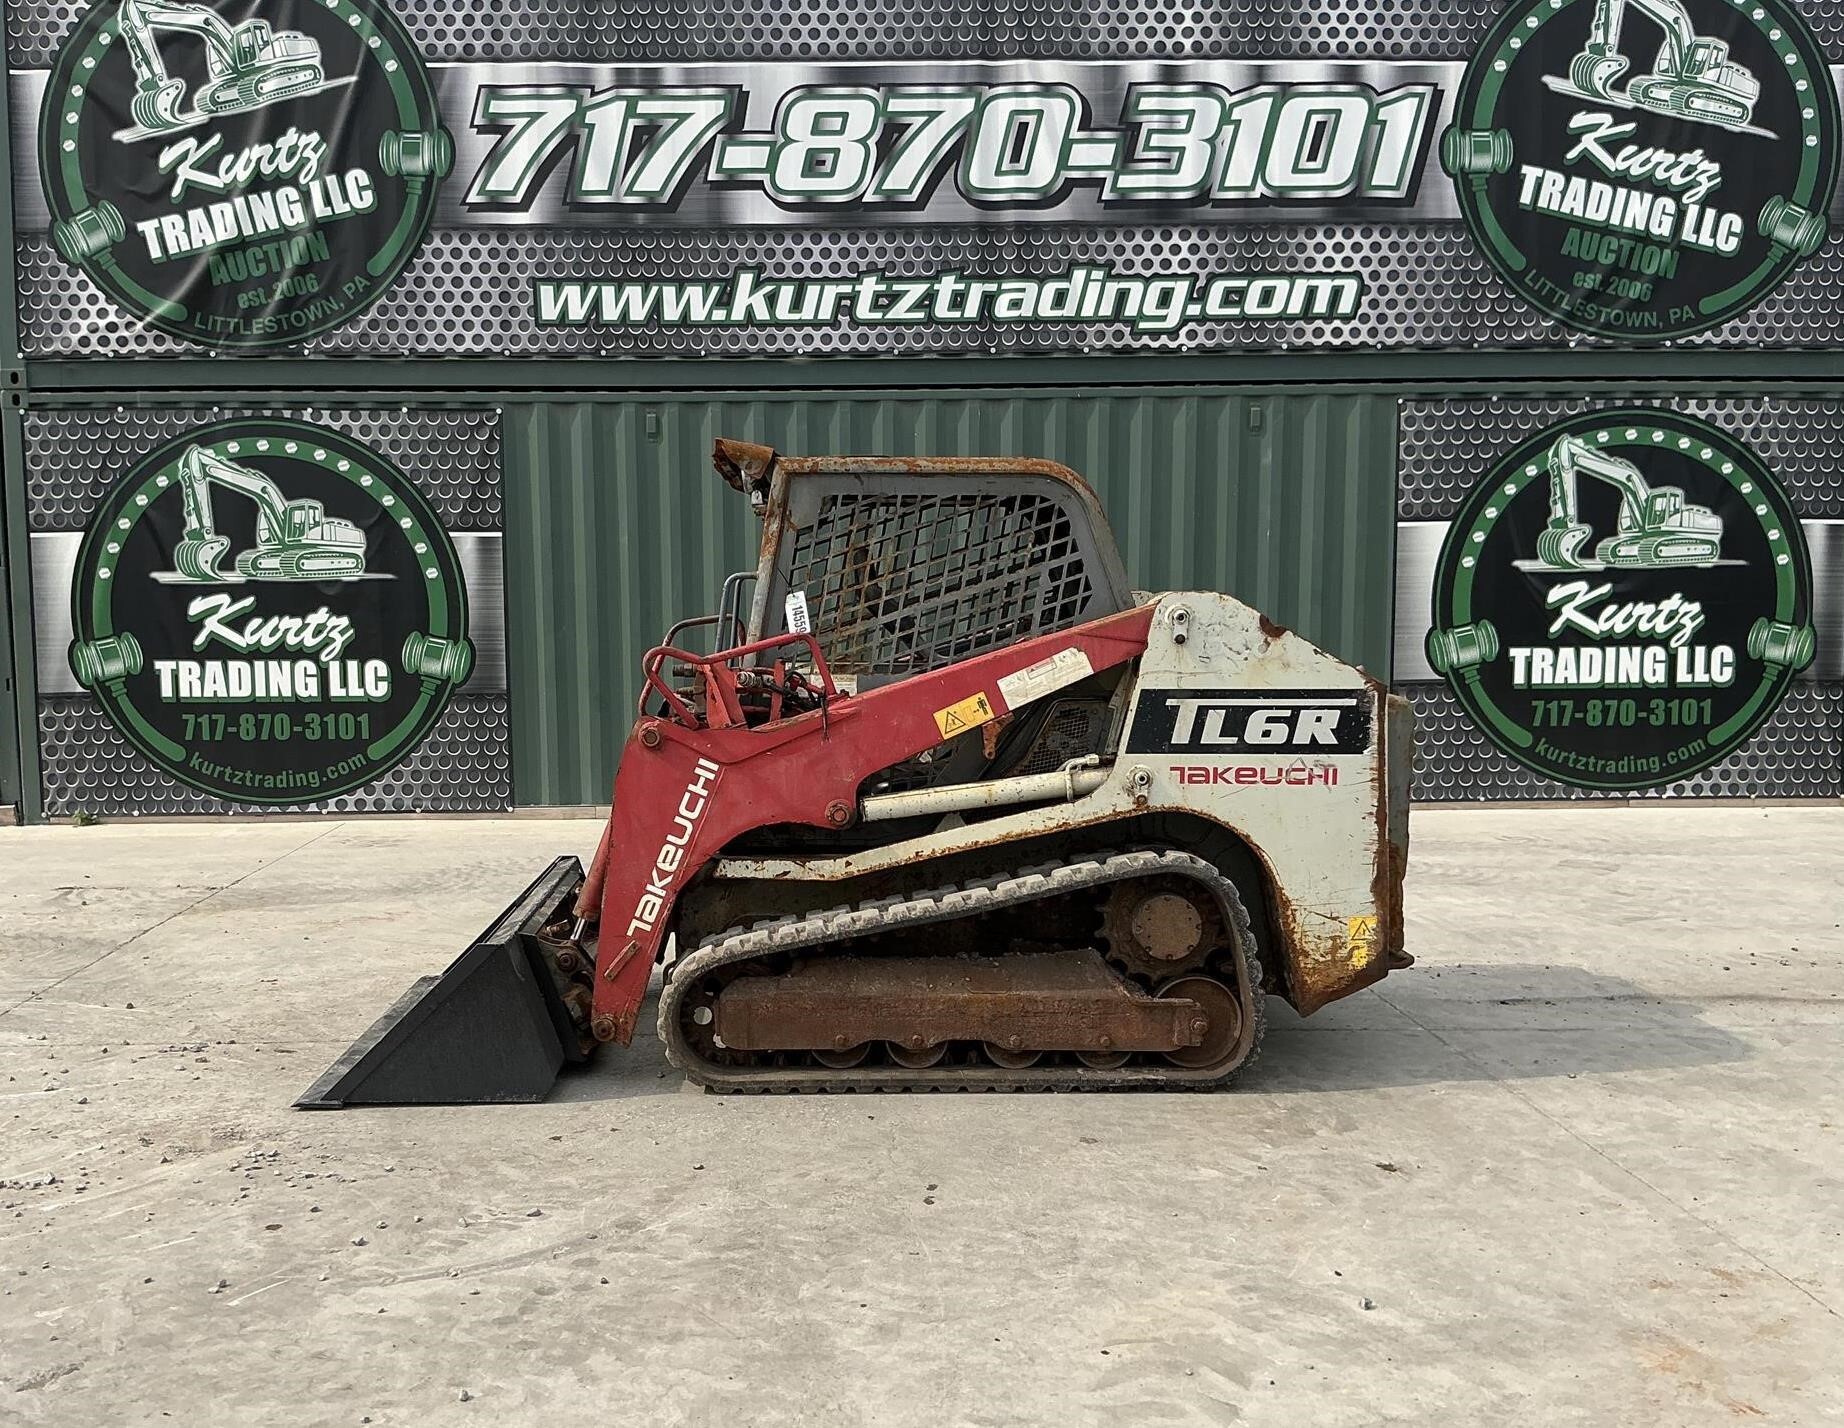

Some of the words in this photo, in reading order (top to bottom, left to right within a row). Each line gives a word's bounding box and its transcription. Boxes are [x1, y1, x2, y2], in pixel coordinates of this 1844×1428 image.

[160, 127, 327, 197] Kurtz
[476, 89, 1431, 201] 717-870-3101
[1565, 111, 1722, 204] Kurtz
[137, 184, 307, 262] TRADING
[309, 169, 377, 220] LLC
[1518, 165, 1679, 241] TRADING
[1681, 203, 1745, 257] LLC
[208, 230, 331, 287] AUCTION
[1560, 227, 1680, 280] AUCTION
[194, 296, 345, 335] LITTLESTOWN,
[341, 275, 371, 300] PA
[237, 287, 272, 310] est.
[272, 273, 320, 301] 2006
[536, 269, 1360, 332] www.kurtztrading.com
[1524, 268, 1664, 329] LITTLESTOWN,
[1668, 304, 1696, 326] PA
[1572, 271, 1602, 291] est.
[1605, 276, 1653, 302] 2006
[187, 593, 354, 661] Kurtz
[1546, 581, 1706, 647] Kurtz
[154, 660, 320, 702] TRADING
[326, 659, 392, 702] LLC
[1509, 646, 1670, 689] TRADING
[1673, 645, 1736, 688] LLC
[181, 713, 372, 742] 717-870-3101
[1165, 698, 1357, 745] TL6R
[1531, 698, 1713, 728] 717-870-3101
[190, 752, 367, 789] kurtztrading.com
[1535, 737, 1707, 775] kurtztrading.com
